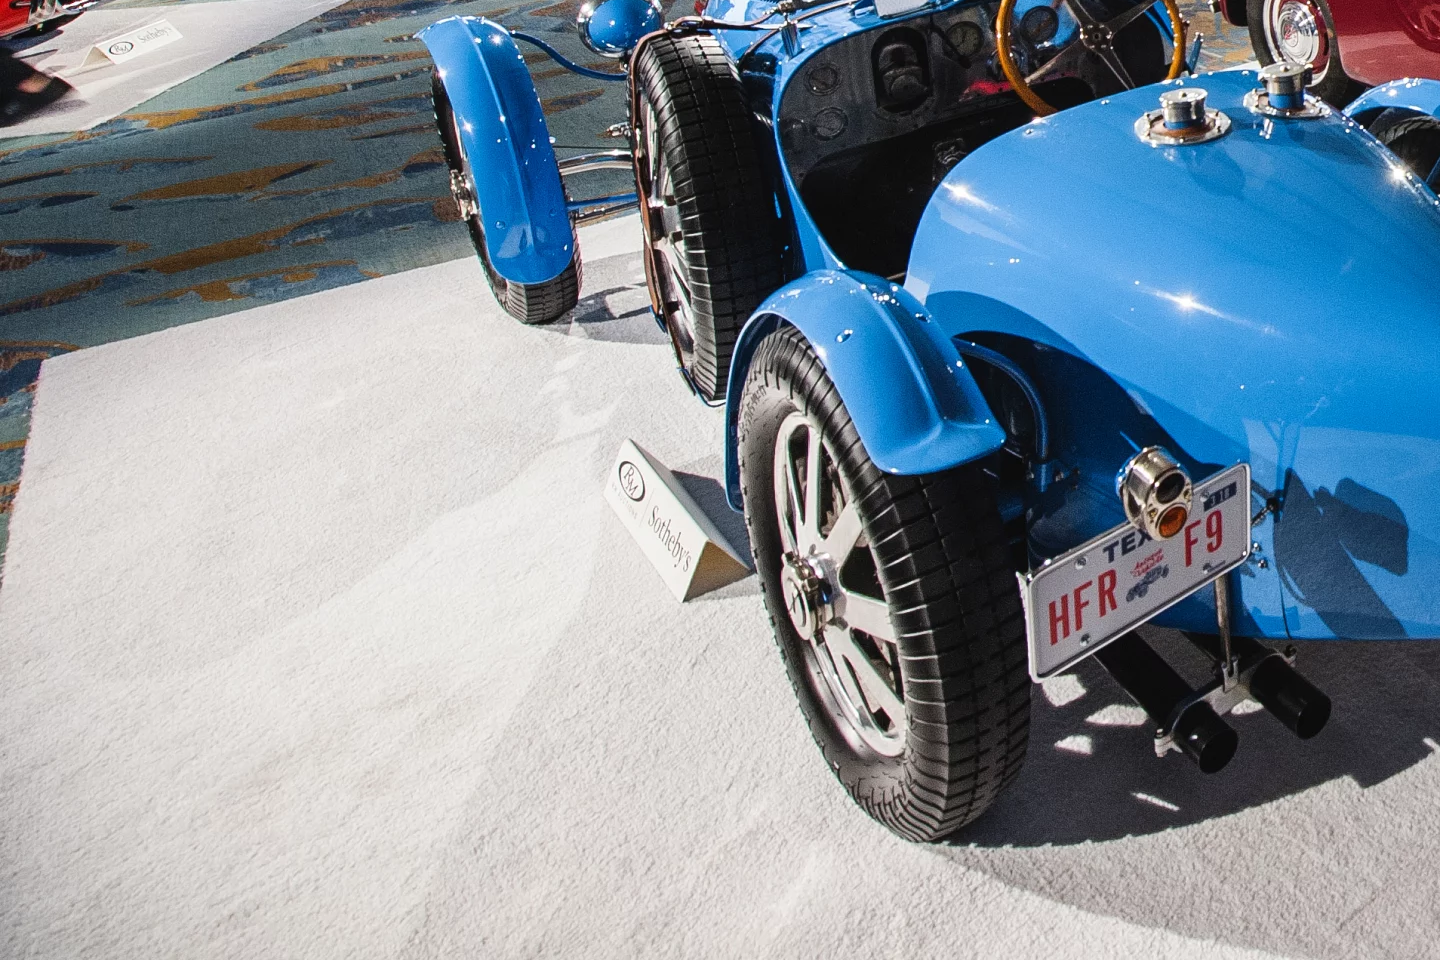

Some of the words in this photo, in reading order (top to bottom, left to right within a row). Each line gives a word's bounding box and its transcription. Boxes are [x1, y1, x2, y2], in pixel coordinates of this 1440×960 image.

[623, 466, 638, 496] RM
[648, 505, 692, 573] Sotheby's
[1102, 528, 1154, 563] TEX
[1049, 569, 1118, 646] HFR
[1184, 509, 1223, 567] F9
